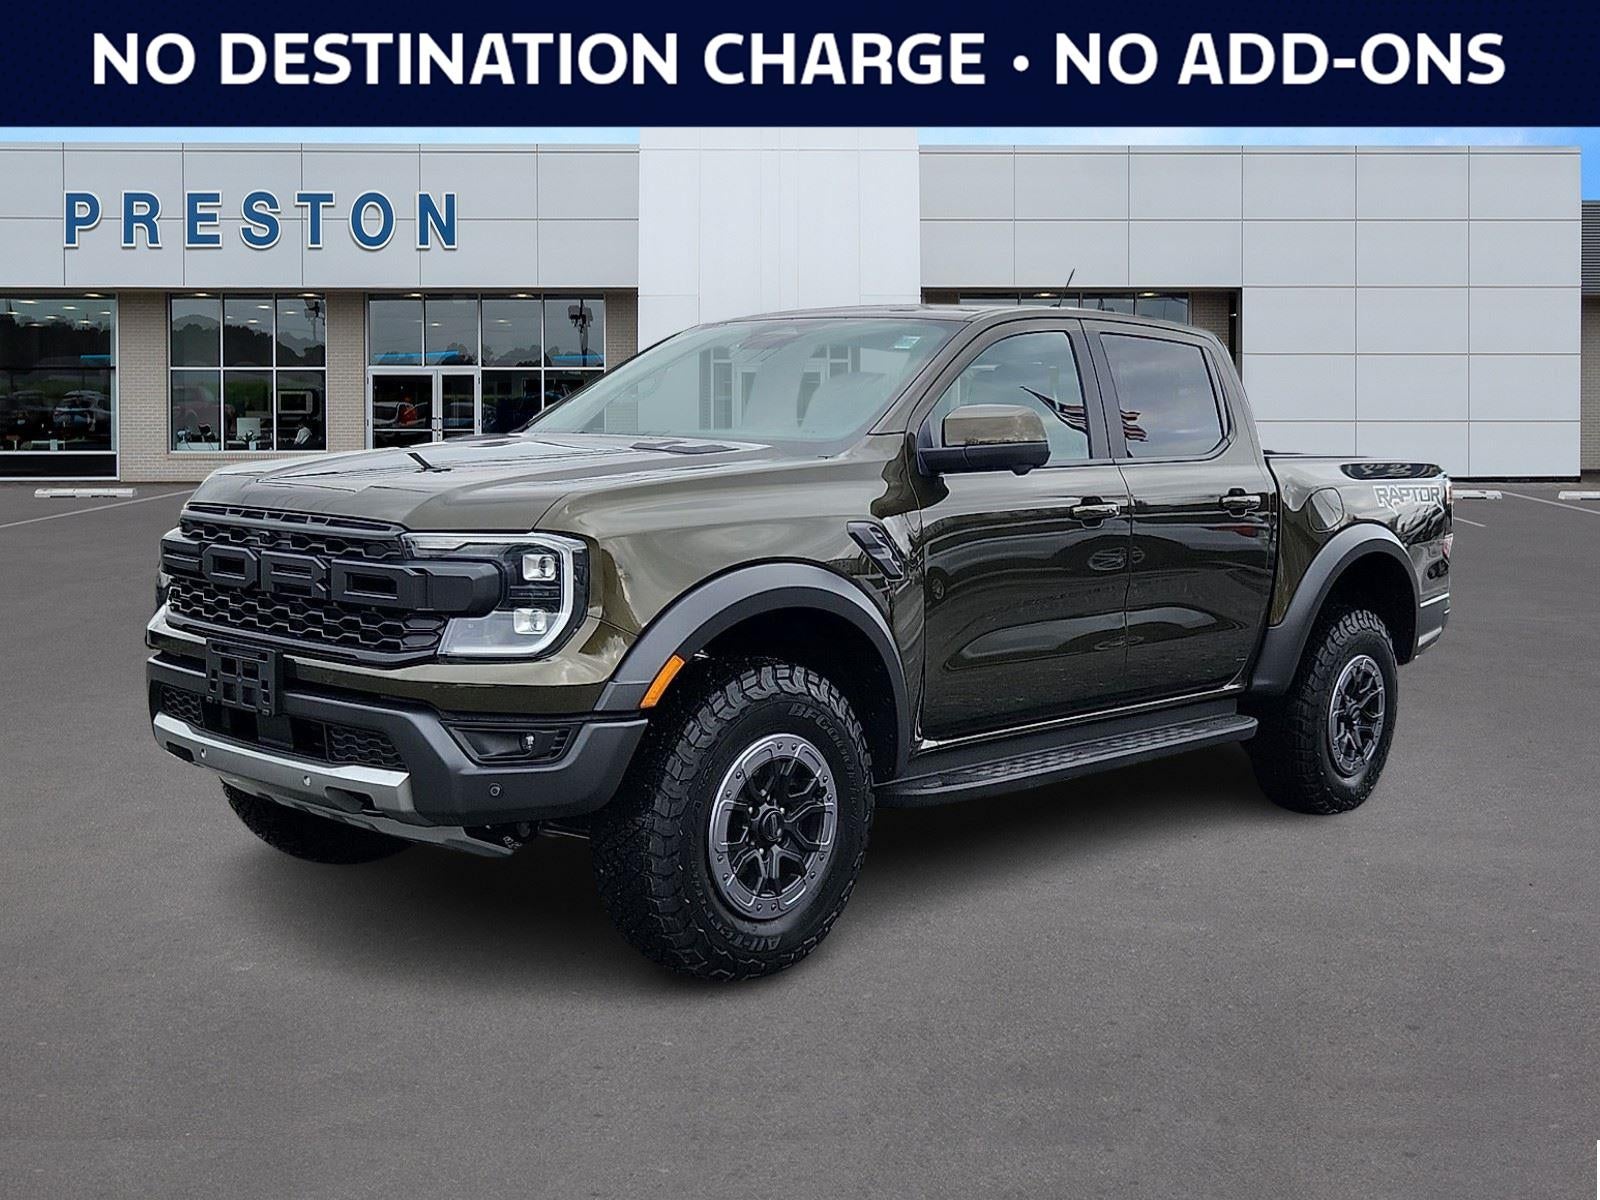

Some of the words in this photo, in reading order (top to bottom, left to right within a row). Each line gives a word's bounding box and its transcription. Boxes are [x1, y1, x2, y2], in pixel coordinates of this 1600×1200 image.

[63, 190, 459, 251] PRESTON
[1373, 484, 1444, 510] RAPTOR
[160, 538, 424, 611] FORD
